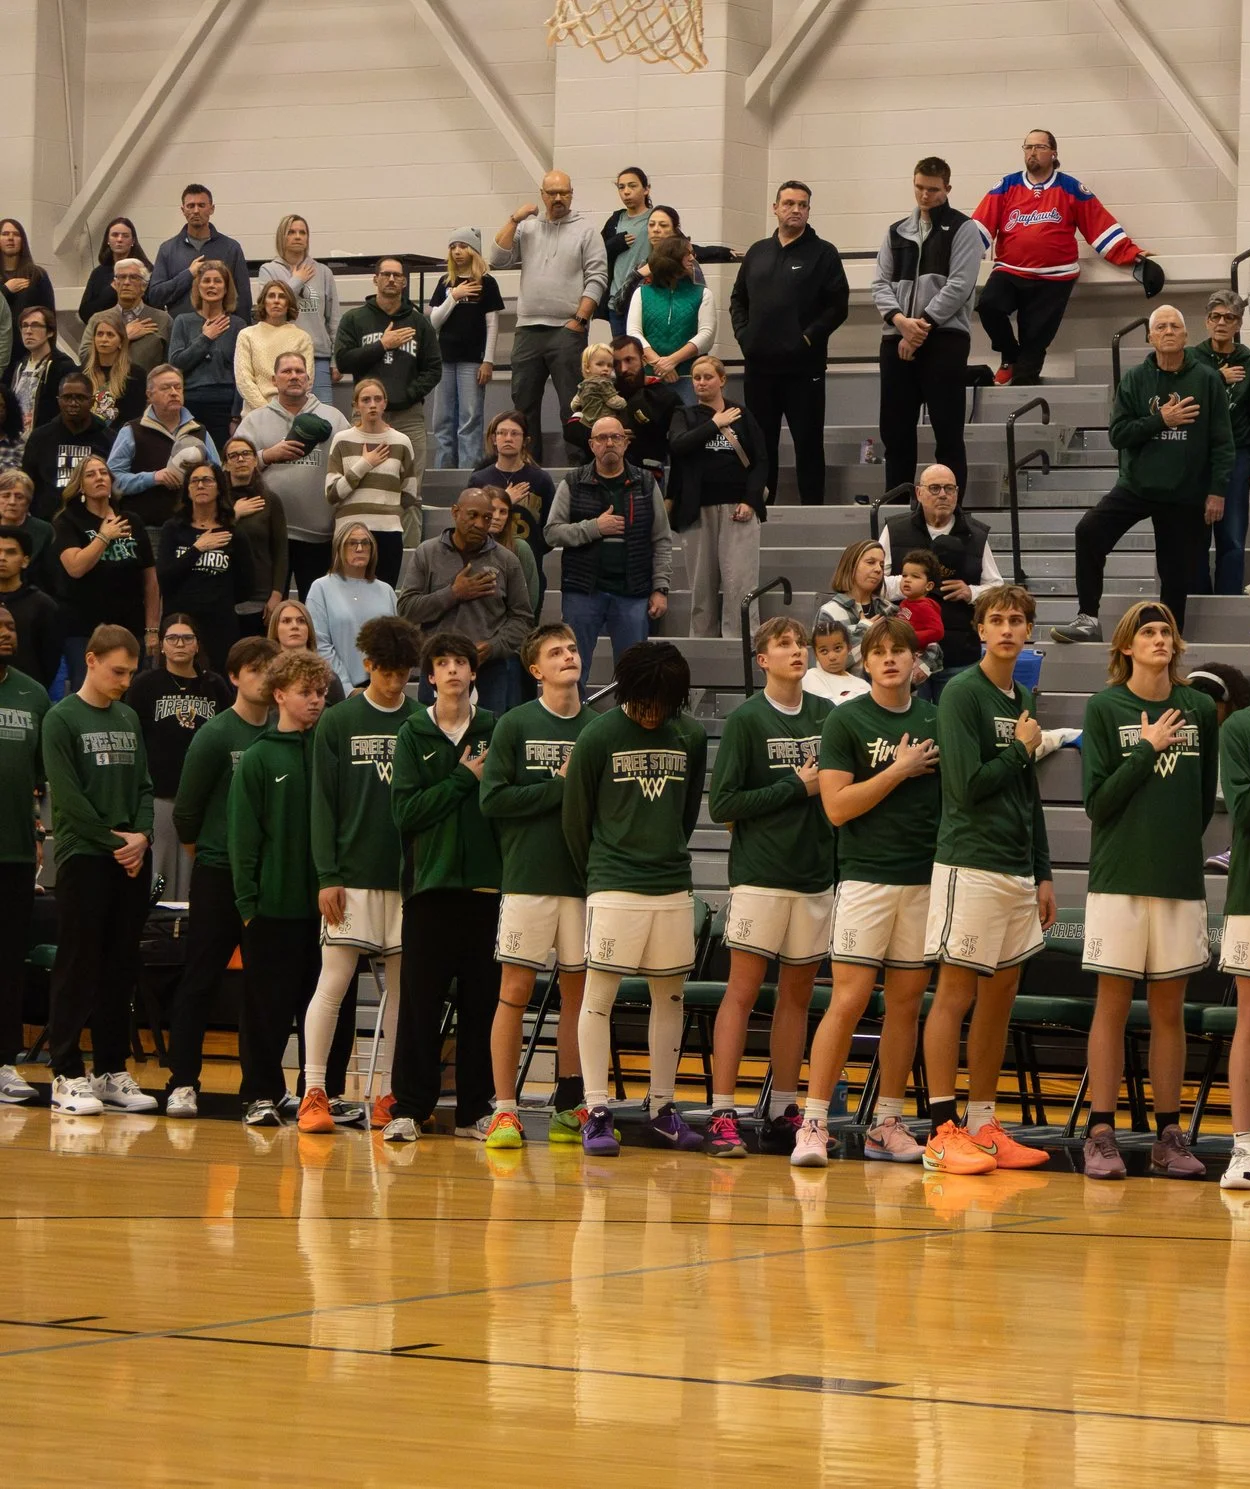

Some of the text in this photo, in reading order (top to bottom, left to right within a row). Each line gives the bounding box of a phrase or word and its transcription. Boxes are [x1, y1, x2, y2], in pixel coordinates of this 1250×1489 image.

[1004, 206, 1062, 232] Jayhawks
[1161, 430, 1187, 440] STATE
[155, 699, 216, 721] FIREBIRDS
[81, 731, 111, 753] FREE
[351, 739, 385, 756] FREE
[1119, 729, 1141, 748] FR
[525, 744, 560, 761] FREE
[767, 740, 800, 760] FREE
[612, 753, 687, 774] FREE STATE
